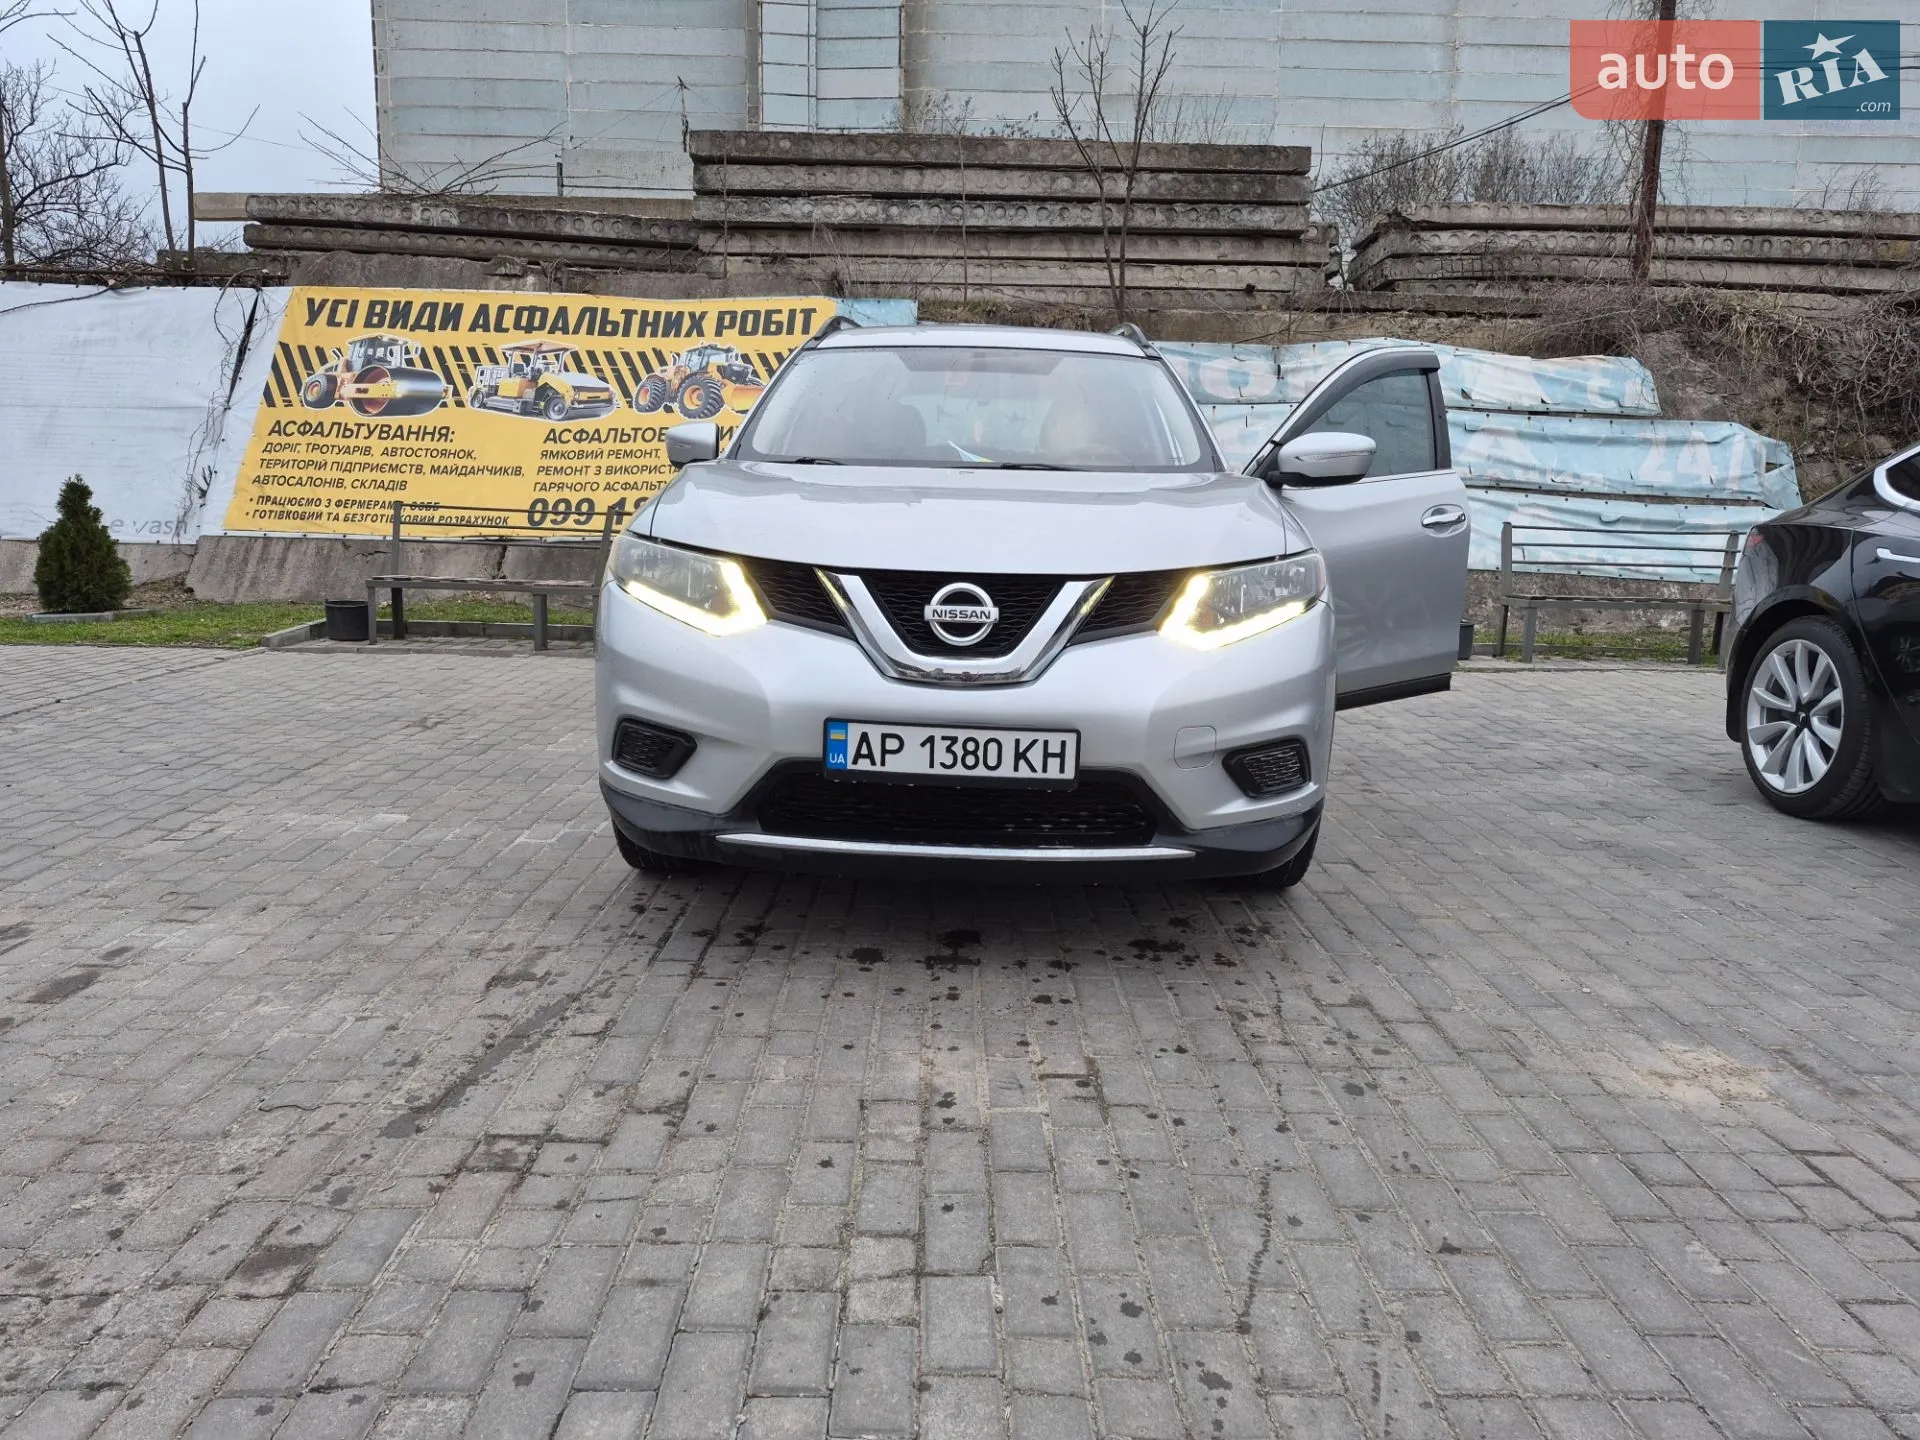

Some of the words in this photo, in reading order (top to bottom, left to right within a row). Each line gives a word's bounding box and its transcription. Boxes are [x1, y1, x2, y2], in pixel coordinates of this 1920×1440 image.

[304, 297, 359, 328] УСІ
[363, 299, 464, 332] ВИДИ
[468, 304, 708, 338] АСФАЛЬТНИХ
[714, 307, 818, 338] РОБІТ
[268, 419, 455, 443] АСФАЛЬТУВАННЯ:
[305, 442, 374, 457] ТРОТУАРІВ,
[380, 446, 477, 460] АВТОСТОЯНОК,
[540, 448, 604, 461] ЯМКОВИЙ
[606, 448, 661, 461] РЕМОНТ,
[259, 458, 328, 472] ТЕРИТОРІЙ
[330, 460, 426, 476] ПІДПРИЄМСТВ,
[429, 464, 525, 478] МАЙДАНЧИКІВ,
[537, 465, 593, 476] РЕМОНТ
[252, 475, 347, 490] АВТОСАЛОНІВ,
[351, 478, 408, 492] СКЛАДІВ
[533, 481, 600, 493] ГАРЯЧОГО
[603, 480, 667, 493] АСФАЛЬТ
[256, 495, 322, 508] ПРАЦЮЄМО
[252, 509, 323, 521] ГОТІВКОВИЙ
[327, 511, 340, 522] ТА
[438, 514, 510, 526] РОЗРАХУНОК
[527, 497, 596, 527] 099
[931, 608, 991, 620] NISSAN
[829, 752, 845, 765] UA
[851, 731, 905, 767] AP
[920, 734, 1003, 772] 1380
[1013, 738, 1067, 774] KH
